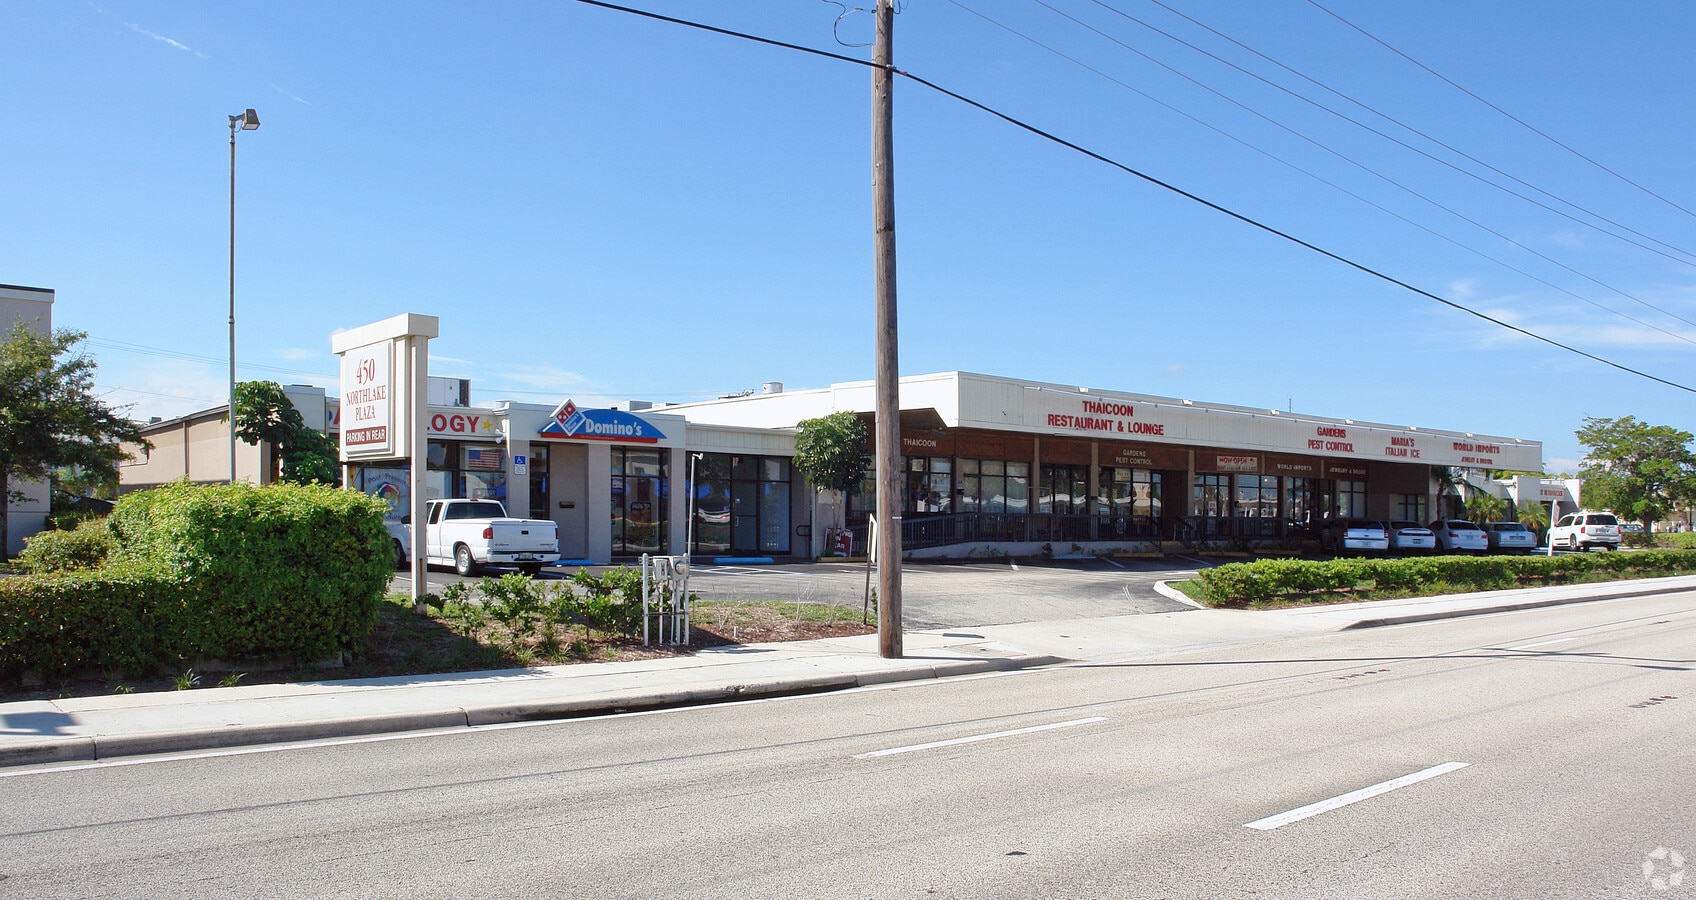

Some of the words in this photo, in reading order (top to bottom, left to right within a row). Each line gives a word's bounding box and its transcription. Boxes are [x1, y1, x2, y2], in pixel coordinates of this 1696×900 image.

[356, 358, 376, 385] 450
[346, 385, 387, 406] NORTHLAKE
[355, 404, 376, 421] PLAZA
[1082, 400, 1134, 417] THAICOON
[427, 413, 480, 434] OGY
[585, 418, 642, 436] Domino's
[1047, 413, 1114, 432] RESTAURANT
[1117, 421, 1124, 433] &
[1127, 421, 1164, 436] LOUNGE
[346, 430, 366, 443] PARKING
[366, 430, 372, 441] IN
[372, 428, 386, 440] REAR
[1316, 426, 1347, 439] GARDENS
[903, 437, 937, 448] THAICOON
[1307, 439, 1325, 450] PEST
[1326, 440, 1355, 453] CONTROL
[1391, 436, 1415, 447] MARIA'S
[1453, 442, 1473, 452] WORLD
[1475, 444, 1500, 454] IMPORTS
[1122, 448, 1147, 458] GARDENS
[1385, 446, 1408, 458] ITALIAN
[1410, 448, 1420, 459] ICE
[1115, 456, 1128, 465] PEST
[1129, 457, 1152, 466] CONTROL
[1218, 456, 1233, 464] NOW
[1233, 457, 1247, 465] OPEN
[1277, 463, 1293, 471] WORLD
